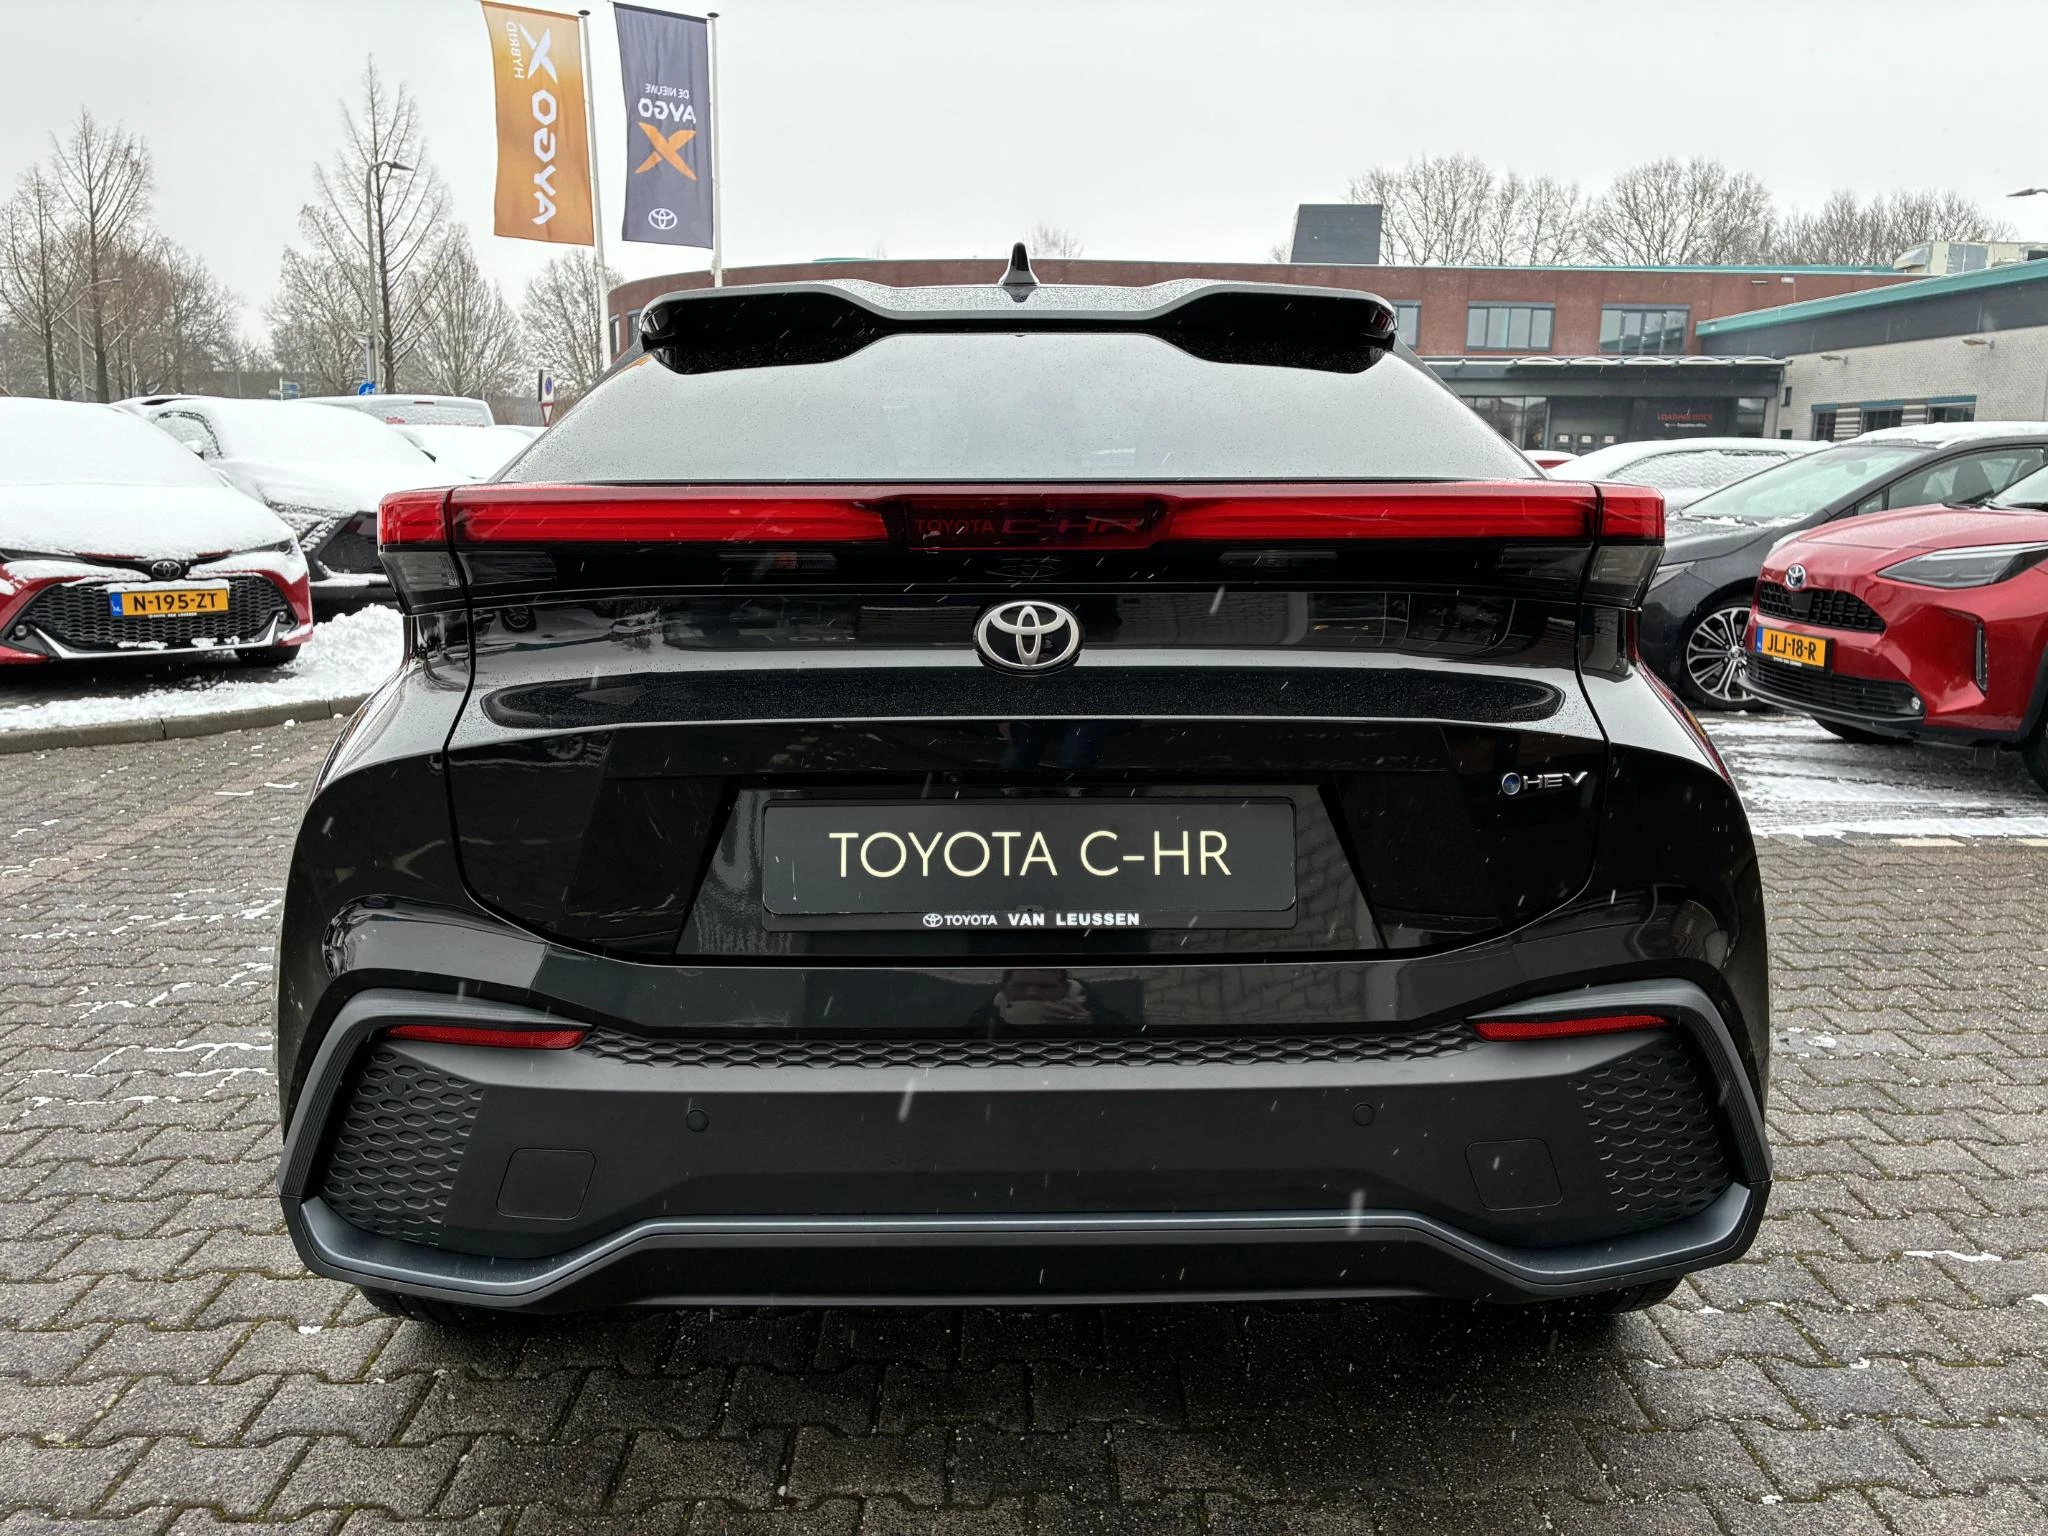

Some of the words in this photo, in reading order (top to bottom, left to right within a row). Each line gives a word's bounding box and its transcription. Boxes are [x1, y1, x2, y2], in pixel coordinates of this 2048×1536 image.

[914, 519, 996, 534] TOYOTA
[133, 592, 217, 612] N-195-ZT
[1767, 633, 1817, 661] JLJ-18-R
[1522, 771, 1589, 790] HEV
[828, 830, 1058, 878] TOYOTA
[1079, 829, 1233, 877] C-HR
[944, 914, 998, 926] TOYOTA
[1007, 912, 1045, 926] VAN
[1055, 912, 1140, 926] LEUSSEN
